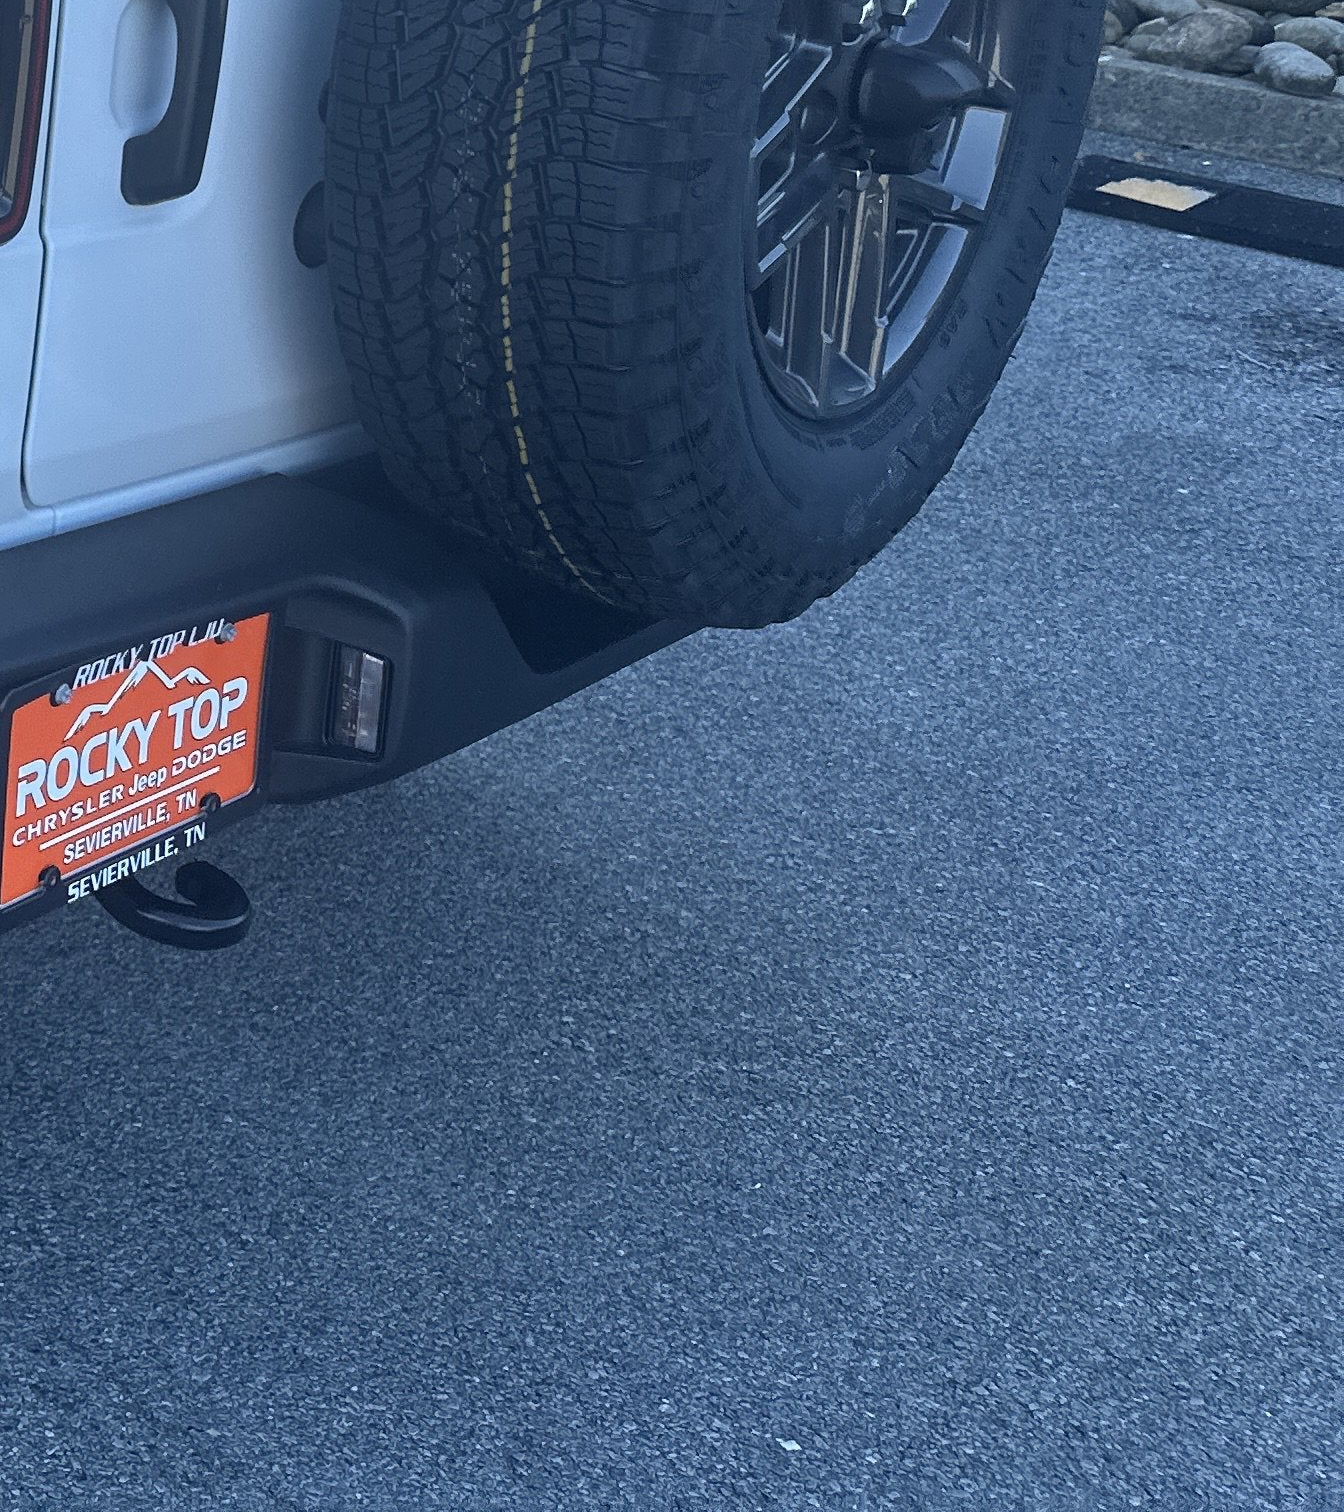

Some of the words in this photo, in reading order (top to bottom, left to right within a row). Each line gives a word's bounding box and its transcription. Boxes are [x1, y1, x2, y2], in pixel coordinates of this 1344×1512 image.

[72, 644, 144, 690] ROCKY
[148, 630, 187, 661] TOP
[12, 784, 125, 847] CHRYSLER
[128, 766, 168, 796] Jeep
[171, 729, 247, 776] DODGE
[15, 710, 162, 818] ROCKY
[168, 676, 248, 750] TOP
[63, 801, 171, 865] SEVIERVILLE,
[176, 789, 198, 814] TN
[67, 836, 180, 904] SEVIERVILLE,
[184, 822, 206, 848] TN
